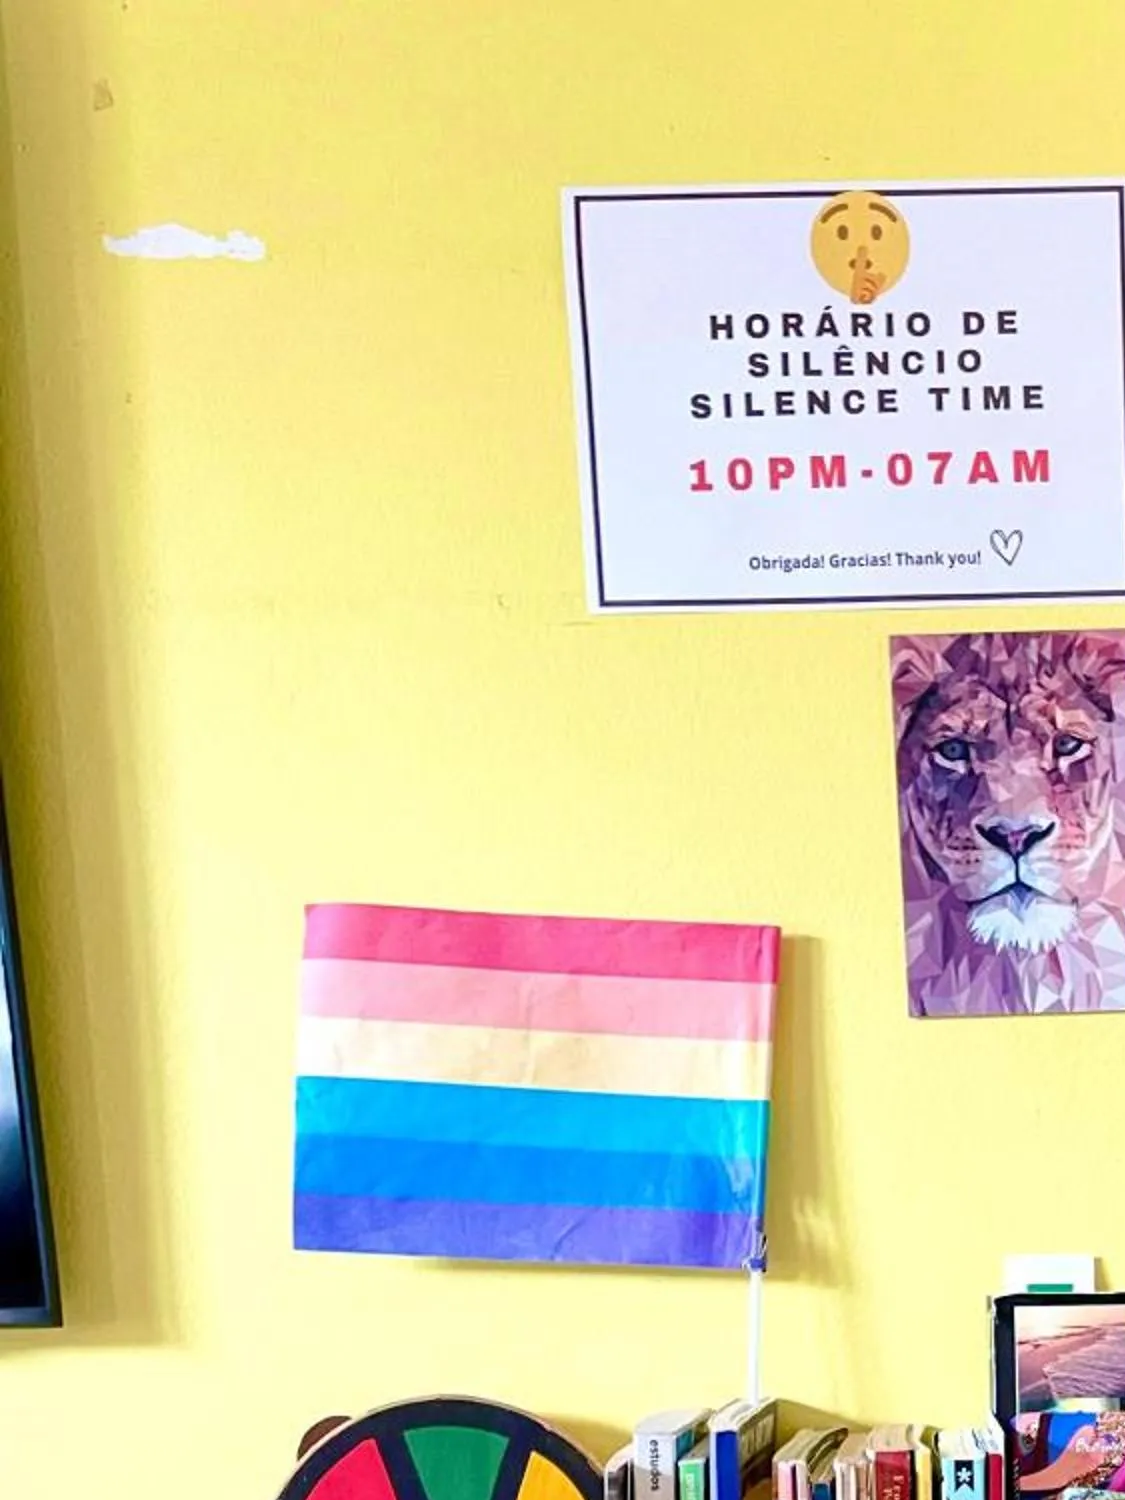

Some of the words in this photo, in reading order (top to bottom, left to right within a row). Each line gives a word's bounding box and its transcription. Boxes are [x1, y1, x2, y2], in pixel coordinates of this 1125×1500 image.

[709, 306, 932, 340] HORÁRIO
[962, 310, 1019, 336] DE
[747, 345, 983, 378] SILÊNCIO
[690, 388, 899, 418] SILENCE
[929, 384, 1044, 411] TIME
[689, 449, 1051, 492] 10PM-07AM
[749, 556, 825, 573] Obrigada!
[829, 553, 892, 569] Gracias!
[896, 551, 943, 567] Thank
[946, 550, 982, 569] you!
[649, 1439, 660, 1490] estudos
